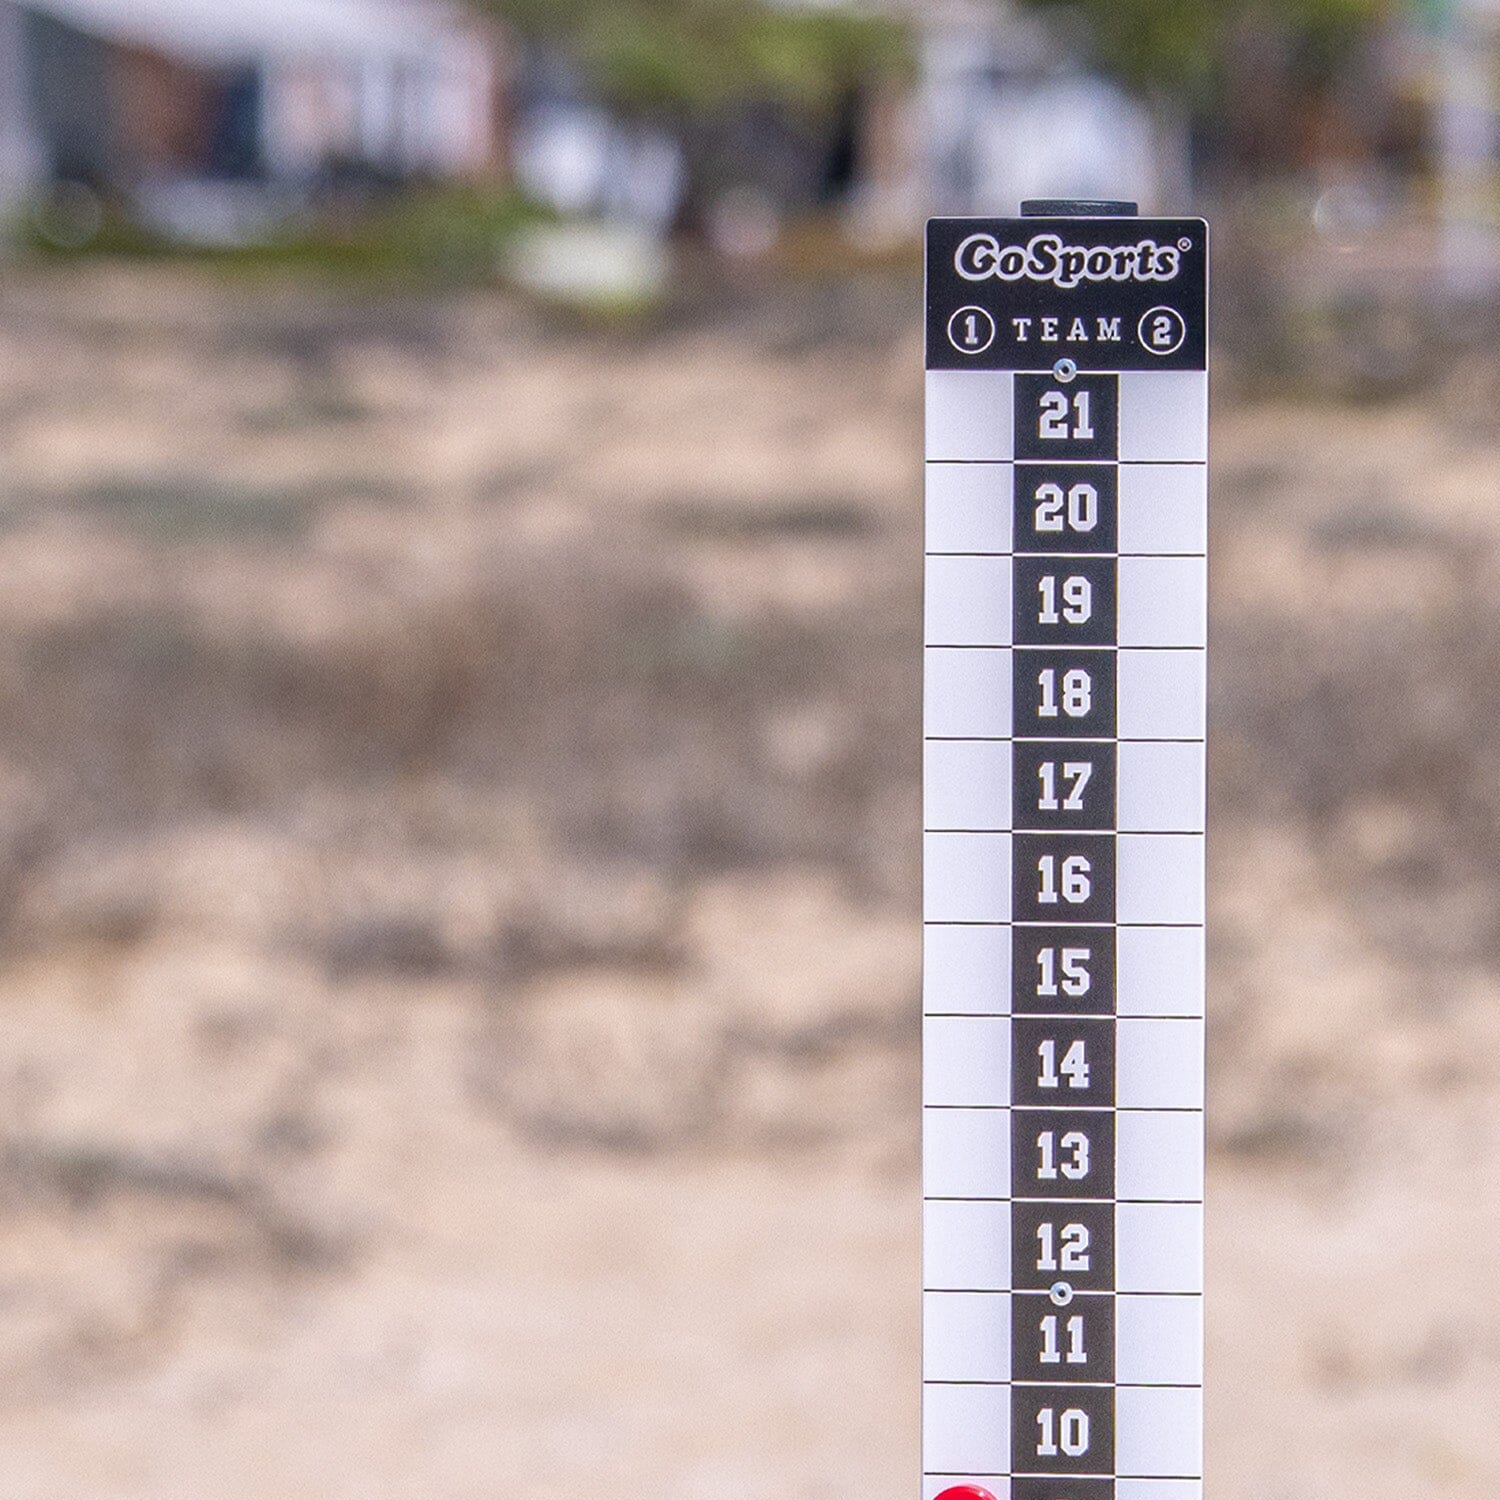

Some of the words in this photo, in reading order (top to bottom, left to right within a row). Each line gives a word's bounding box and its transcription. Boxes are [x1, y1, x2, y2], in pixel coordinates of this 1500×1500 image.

[964, 315, 978, 344] 1
[1012, 318, 1122, 341] TEAM
[1152, 316, 1171, 345] 2
[1038, 390, 1094, 440] 21
[1034, 482, 1098, 533] 20
[1038, 575, 1092, 625] 19
[1038, 668, 1092, 718] 18
[1038, 761, 1093, 811] 17
[1037, 854, 1092, 904] 16
[1036, 947, 1091, 997] 15
[1037, 1039, 1091, 1089] 14
[1036, 1130, 1090, 1180] 13
[1036, 1222, 1090, 1272] 12
[1039, 1315, 1088, 1364] 11
[1036, 1407, 1090, 1457] 10
